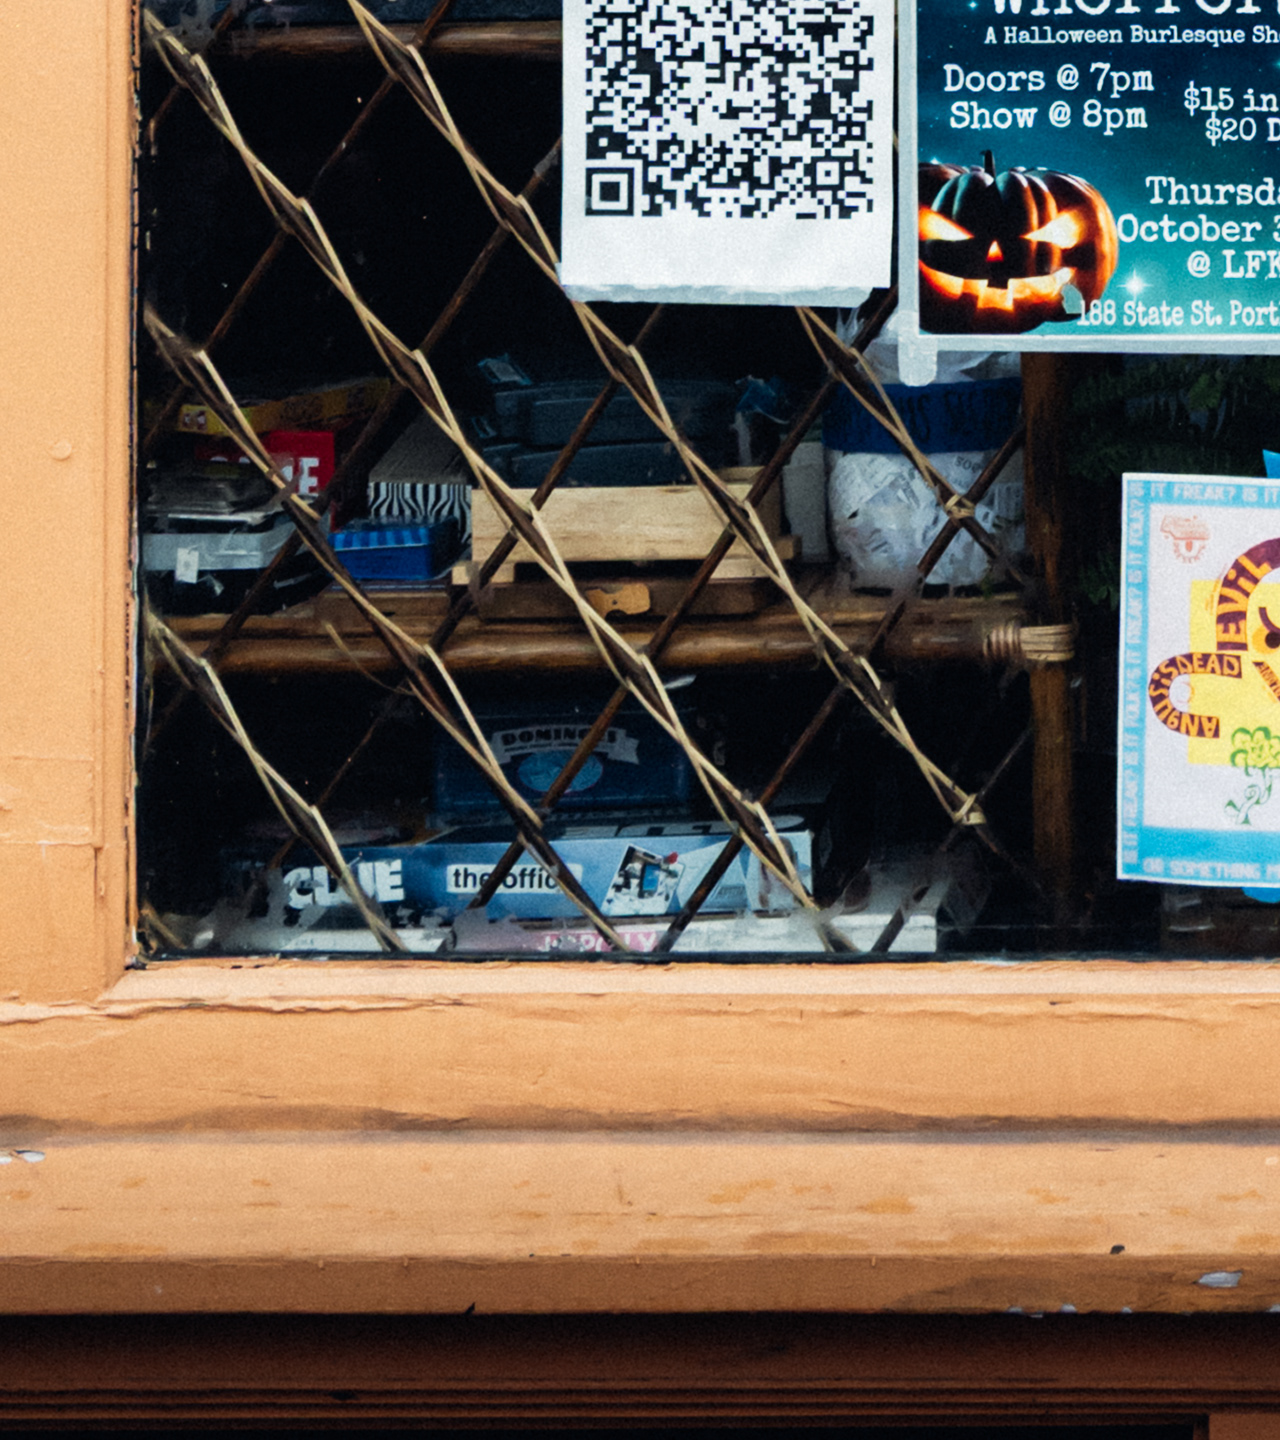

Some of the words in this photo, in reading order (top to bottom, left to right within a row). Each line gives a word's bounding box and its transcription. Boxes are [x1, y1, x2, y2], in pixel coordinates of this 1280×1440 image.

[984, 26, 997, 44] A
[1004, 26, 1123, 44] Halloween
[1130, 25, 1245, 47] Burlesque
[943, 64, 1045, 92] Doors
[1057, 64, 1079, 90] @
[1090, 62, 1154, 98] 7pm
[1184, 81, 1234, 120] $15
[1243, 88, 1279, 112] in
[950, 101, 1038, 130] Show
[1049, 101, 1071, 128] @
[1083, 99, 1148, 135] 8pm
[1206, 112, 1256, 146] $20
[1117, 214, 1262, 242] October
[1187, 251, 1210, 278] @
[1077, 300, 1116, 325] 188
[1124, 300, 1184, 326] State
[1191, 300, 1223, 326] St.
[503, 867, 559, 889] offic
